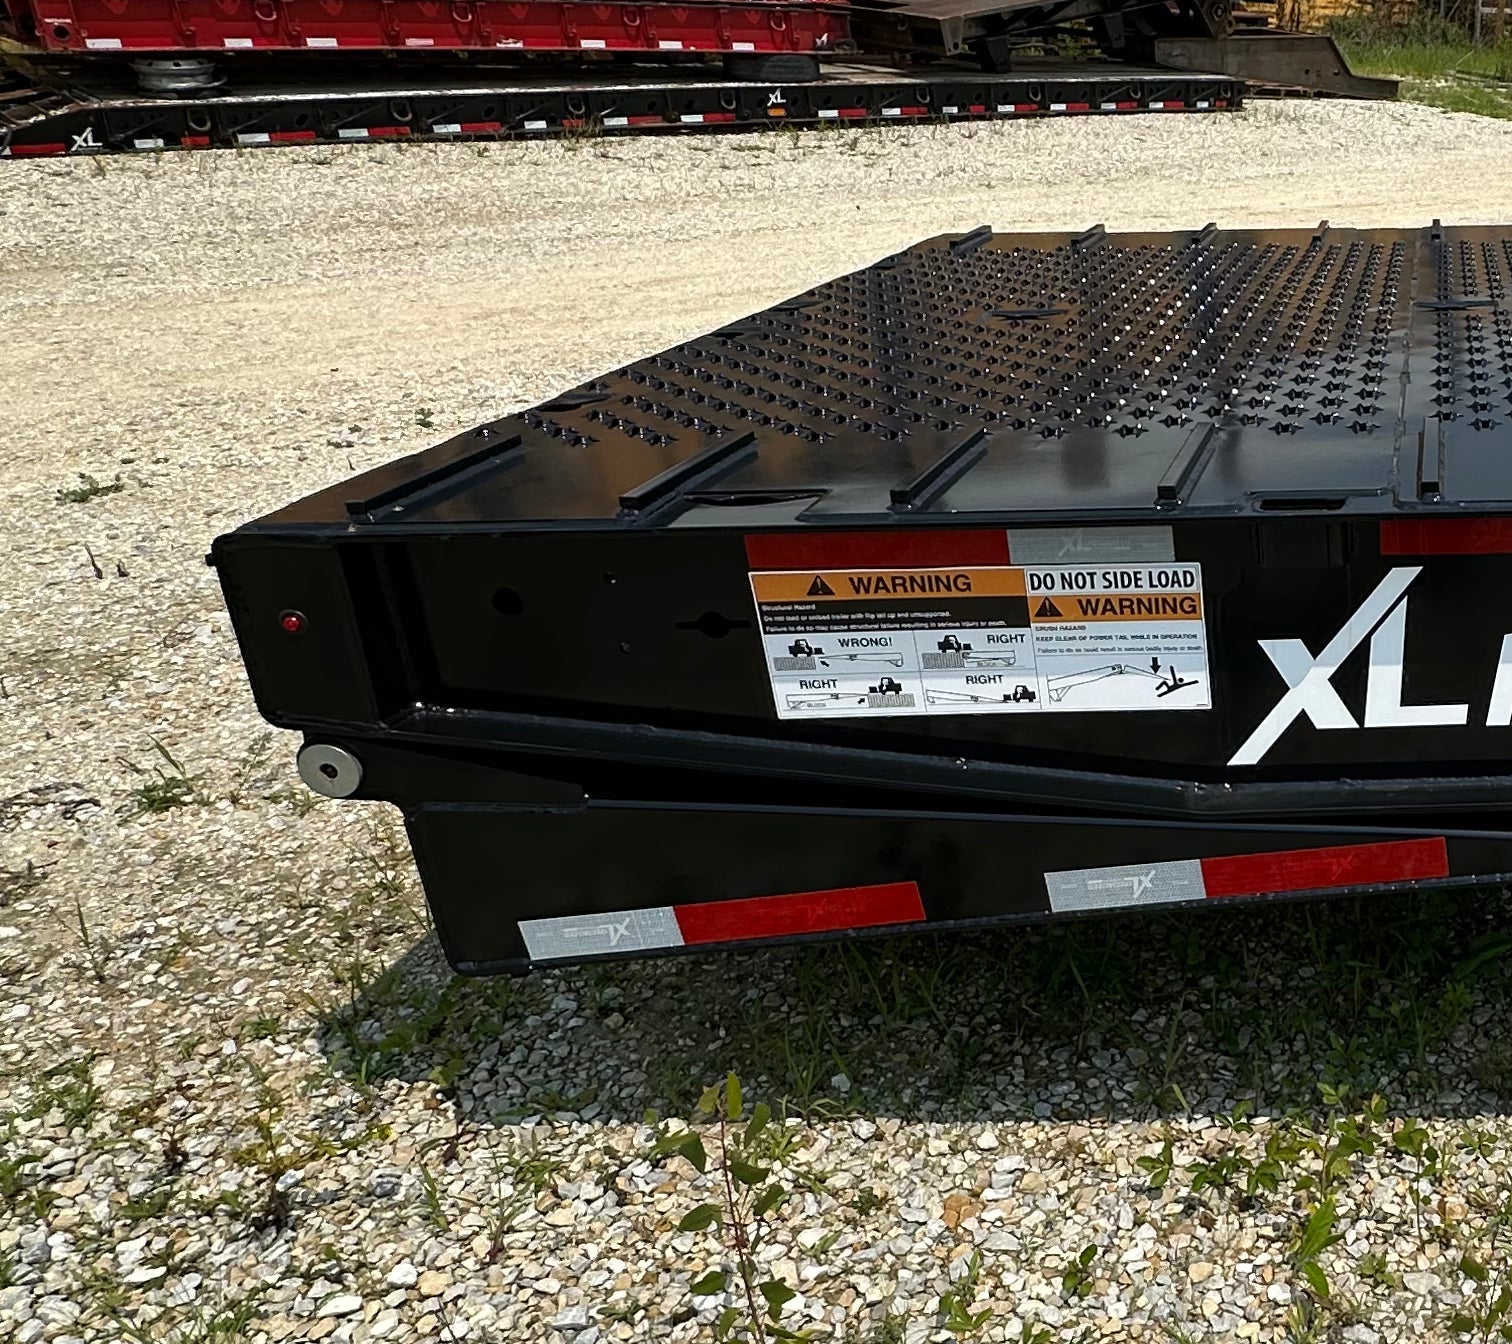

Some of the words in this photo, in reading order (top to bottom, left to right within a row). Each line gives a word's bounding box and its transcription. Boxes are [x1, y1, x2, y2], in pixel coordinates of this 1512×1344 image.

[767, 87, 787, 106] XL
[70, 127, 103, 151] XL
[849, 574, 972, 594] WARNING
[1030, 572, 1055, 591] DO
[1061, 571, 1097, 589] NOT
[1102, 570, 1144, 589] SIDE
[1149, 568, 1195, 588] LOAD
[1077, 596, 1197, 617] WARNING
[838, 638, 893, 647] WRONG!
[987, 634, 1025, 643] RIGHT
[1227, 566, 1468, 765] XL
[800, 679, 838, 689] RIGHT
[966, 675, 1003, 684] RIGHT
